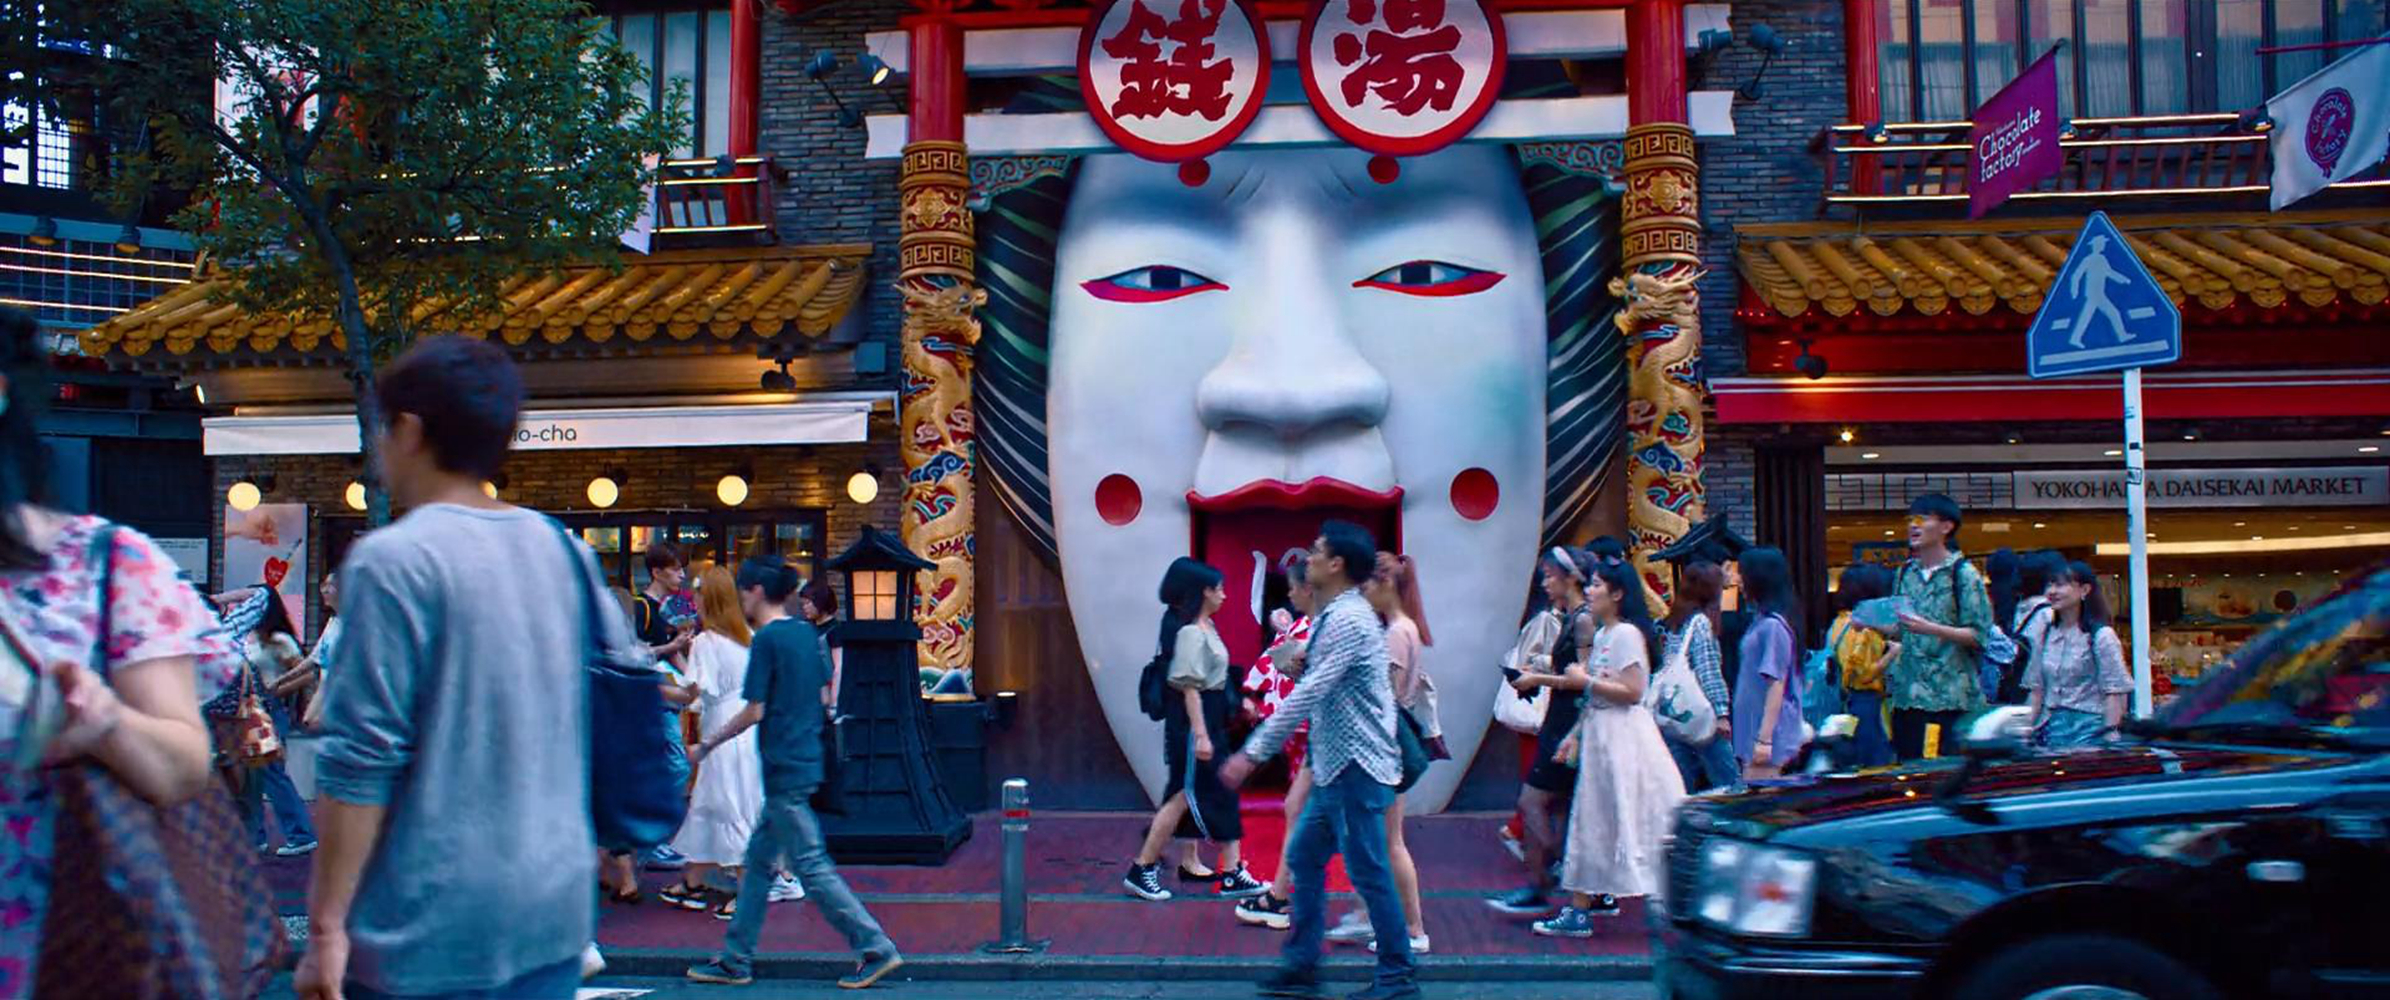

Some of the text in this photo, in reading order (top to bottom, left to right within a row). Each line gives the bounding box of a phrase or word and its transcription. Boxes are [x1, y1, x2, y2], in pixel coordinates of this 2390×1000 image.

[1980, 106, 2041, 160] Chocolate
[1981, 142, 2024, 182] factory
[2032, 476, 2367, 498] YOKOHAA DAISEKAI MARKET
